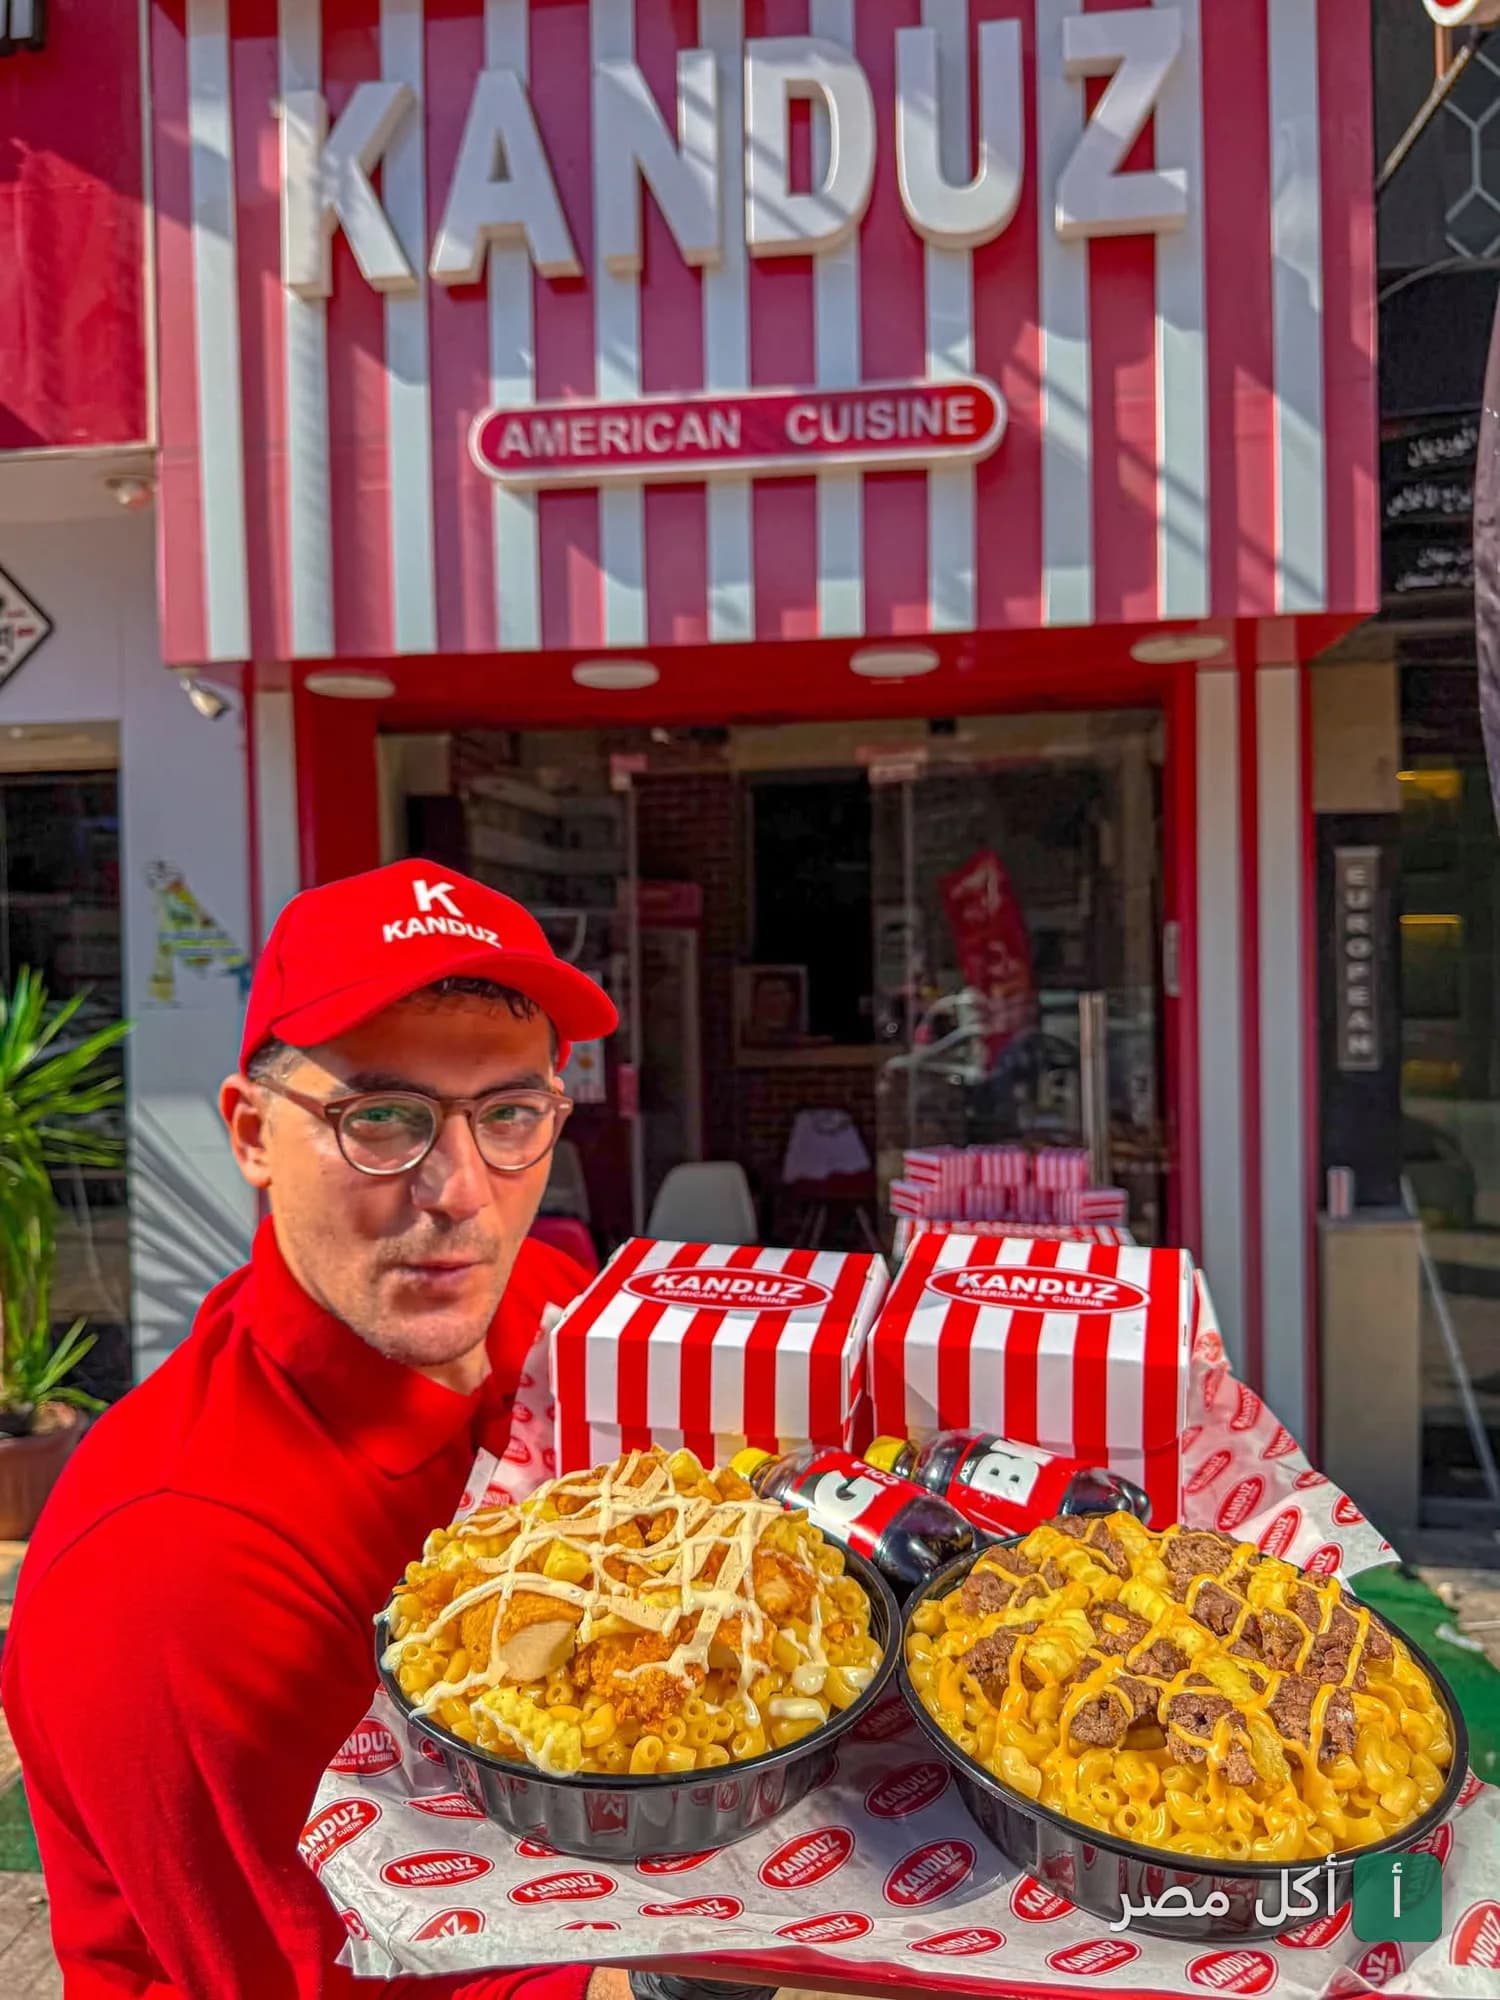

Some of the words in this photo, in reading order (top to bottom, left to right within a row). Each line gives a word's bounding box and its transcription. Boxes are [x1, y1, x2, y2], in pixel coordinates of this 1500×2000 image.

[274, 8, 1188, 299] KANDUZ
[498, 411, 741, 459] AMERICAN
[786, 395, 977, 444] CUISINE
[412, 879, 464, 918] K
[383, 916, 503, 949] KANDUZ
[1346, 865, 1372, 1055] EUROPEAN
[651, 1274, 806, 1299] KANDUZ
[654, 1289, 718, 1299] AMERICAN
[739, 1294, 788, 1305] CUISINE
[955, 1272, 1119, 1301] KANDUZ
[962, 1288, 1028, 1300] AMERICAN
[1051, 1295, 1104, 1307] CUISINE
[850, 1460, 900, 1486] COLA
[1219, 1480, 1255, 1527] KANDUZ
[873, 1766, 939, 1809] KANDUZ
[299, 1803, 366, 1859] ANDUZ
[394, 1856, 479, 1879] KANDUZ
[768, 1833, 841, 1880] KANDUZ
[892, 1843, 962, 1898] KANDUZ
[521, 1874, 602, 1898] KANDUZ
[781, 1915, 860, 1939] KANDUZ
[1055, 1941, 1125, 1971] KANDUZ
[1195, 1951, 1262, 1987] KANDUZ
